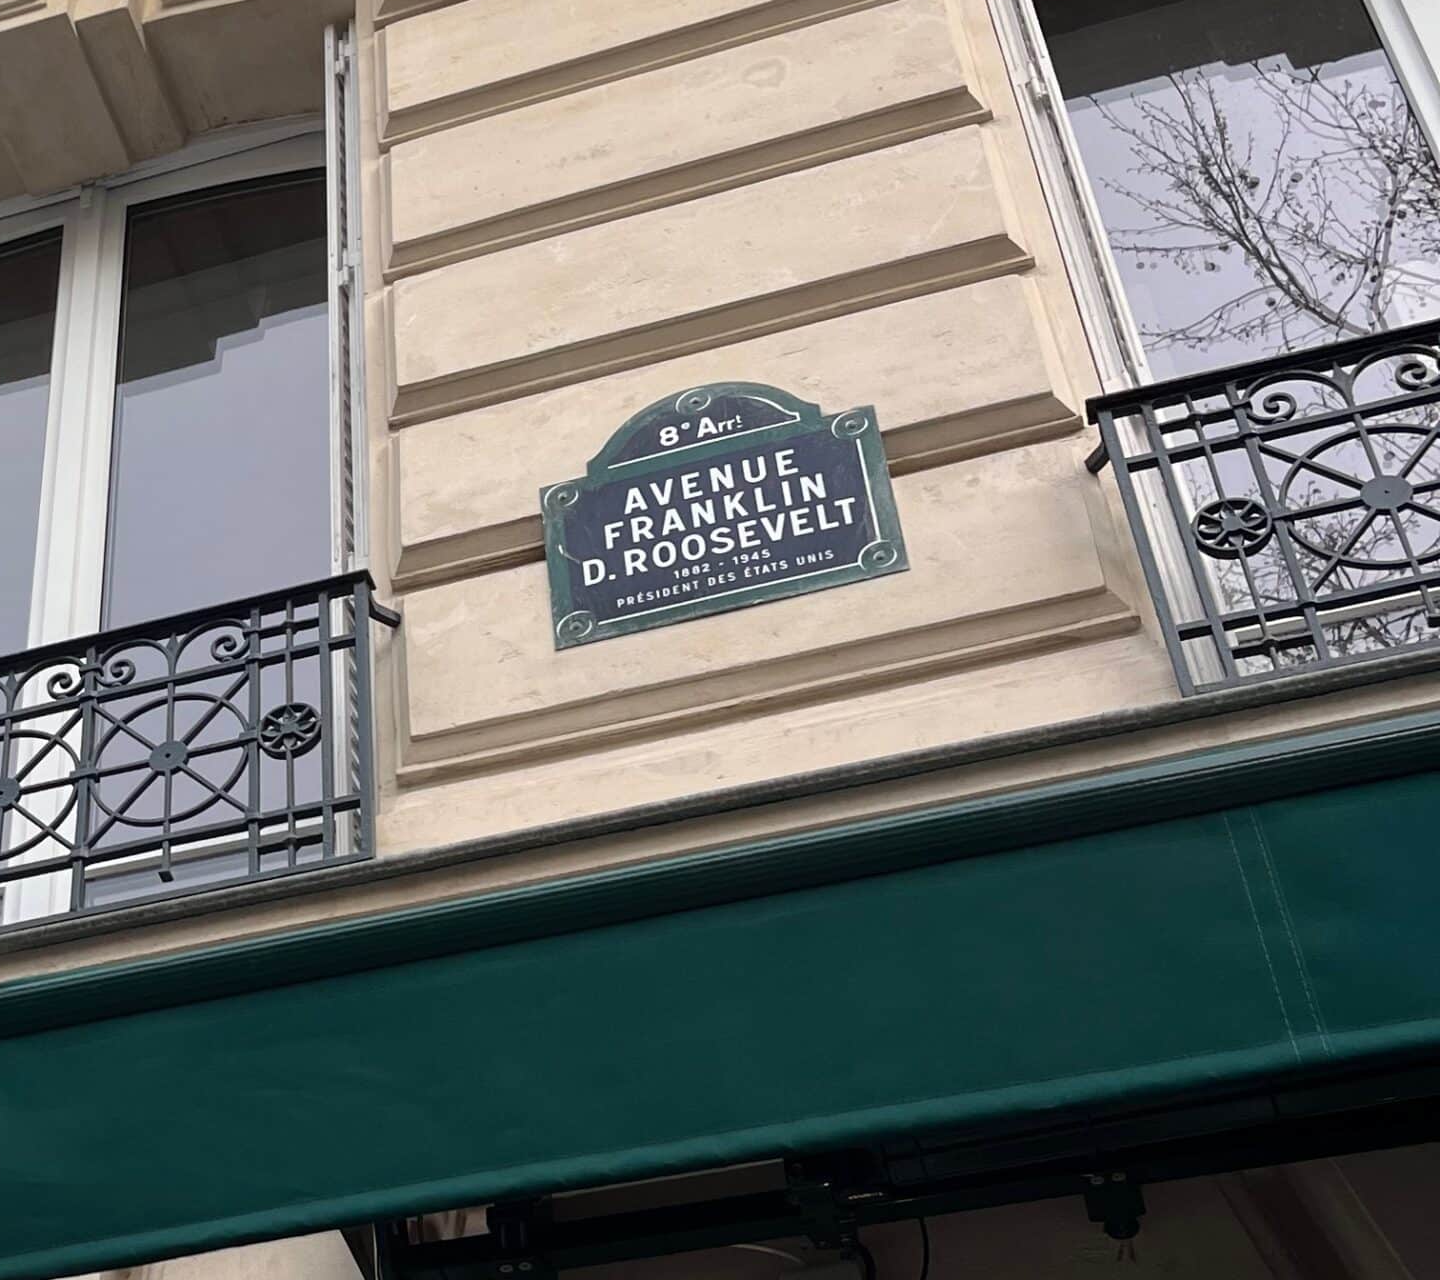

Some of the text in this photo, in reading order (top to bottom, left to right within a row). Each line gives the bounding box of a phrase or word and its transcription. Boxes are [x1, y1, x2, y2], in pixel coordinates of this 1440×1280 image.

[604, 473, 828, 550] FRANKLIN
[624, 449, 799, 515] AVENUE
[623, 497, 857, 576] ROOSEVELT
[732, 548, 772, 566] 1945
[616, 549, 836, 609] PRÉSIDENT DES ÉTATS UNIS
